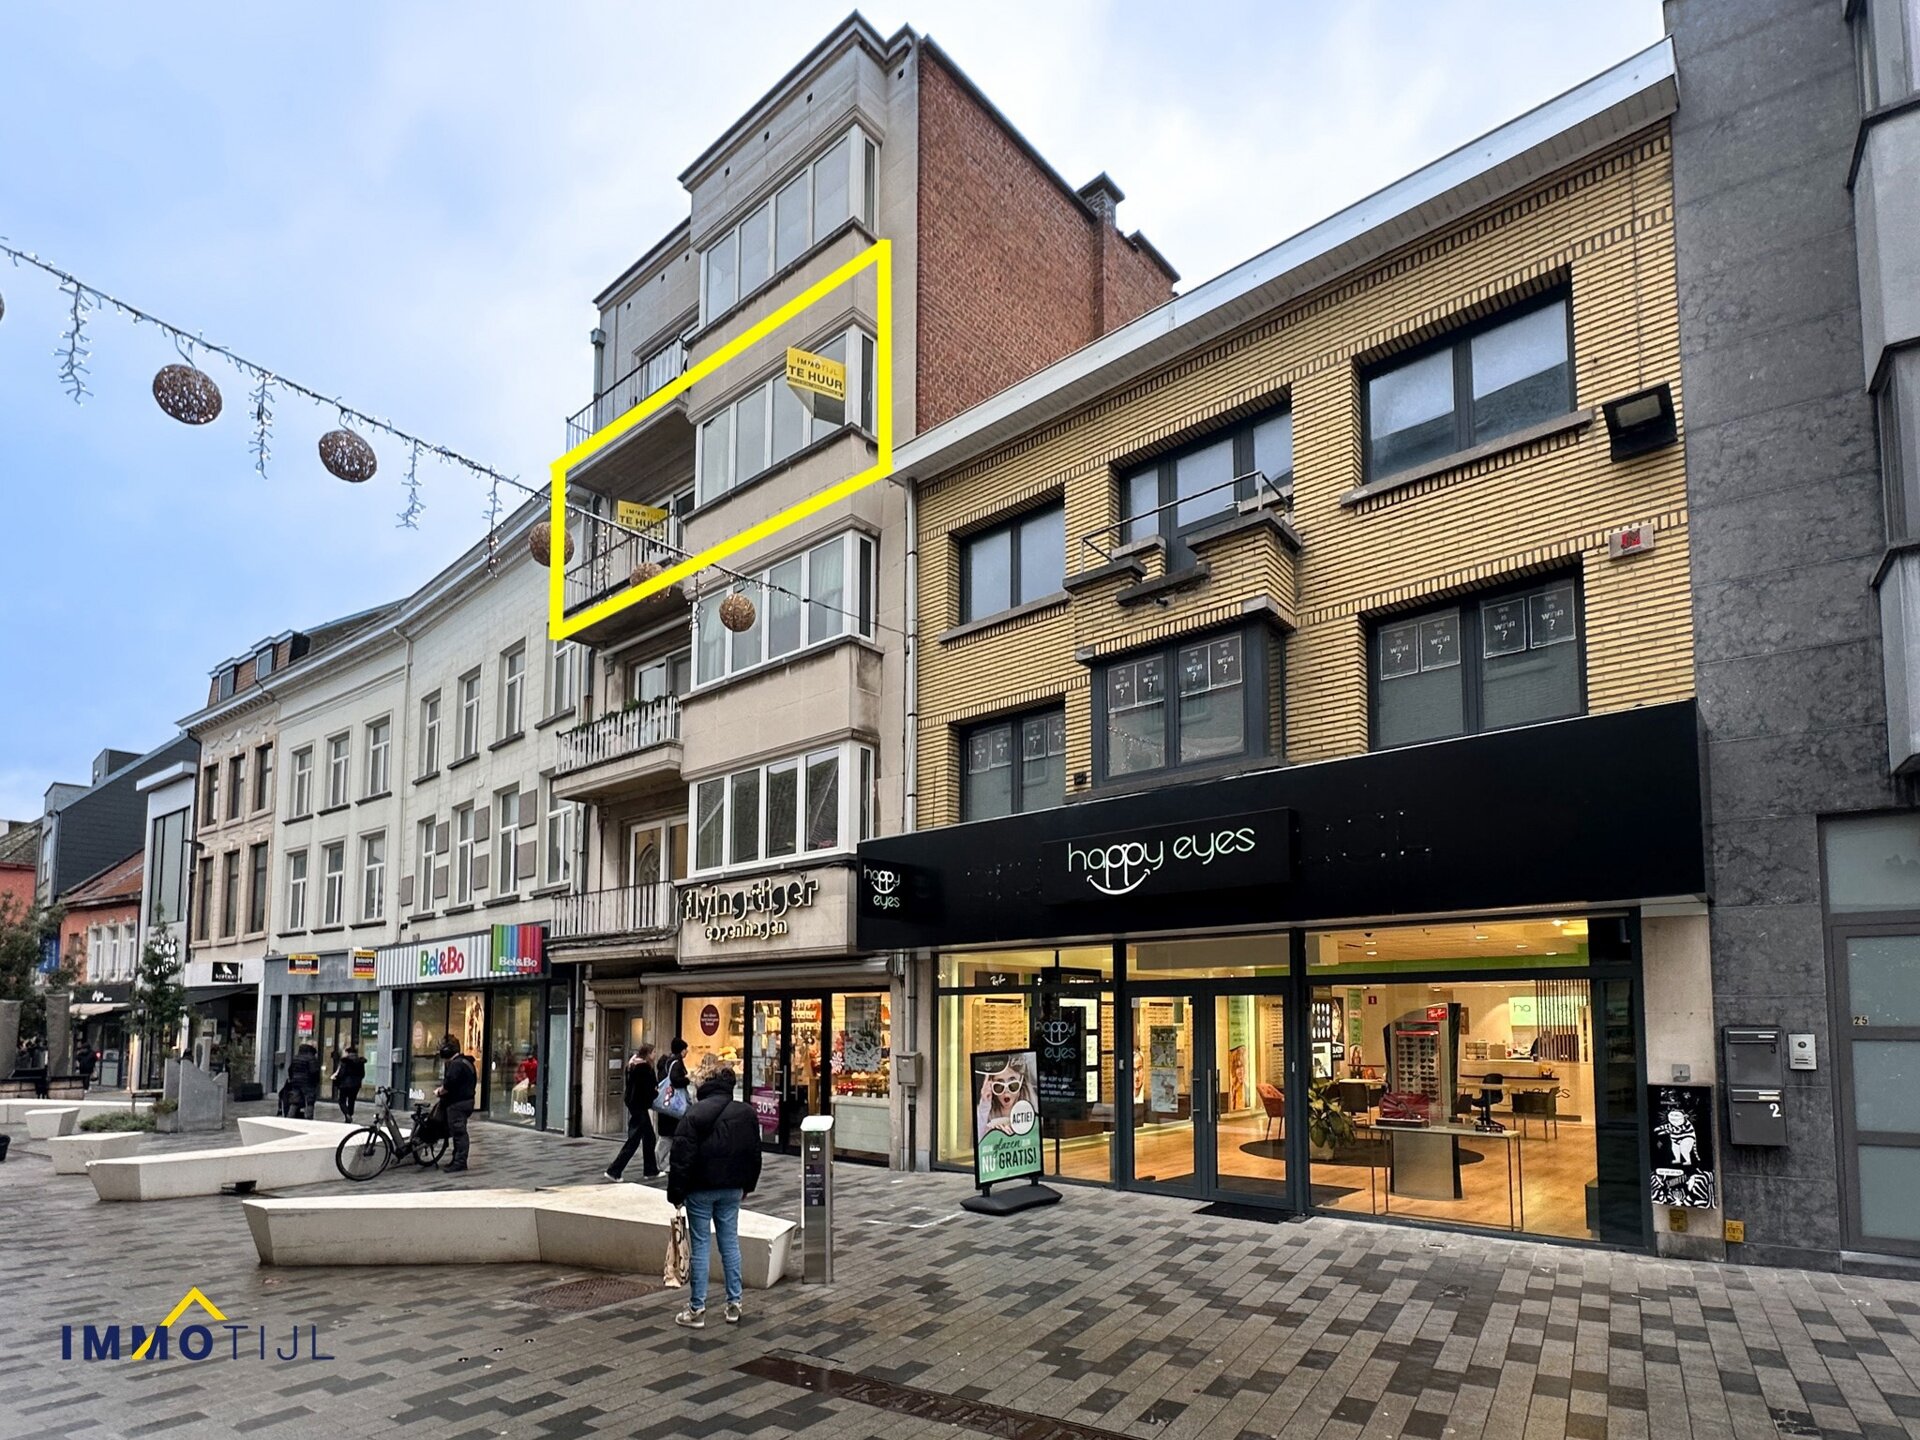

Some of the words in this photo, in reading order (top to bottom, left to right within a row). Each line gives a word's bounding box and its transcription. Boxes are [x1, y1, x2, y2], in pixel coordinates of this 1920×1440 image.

[788, 365, 804, 379] TE
[808, 370, 842, 391] HUUR
[620, 515, 632, 525] TE
[1549, 620, 1556, 630] ?
[1501, 630, 1508, 641] ?
[1437, 644, 1443, 655] ?
[1396, 653, 1402, 664] ?
[1222, 664, 1228, 674] ?
[1191, 672, 1197, 682] ?
[1068, 841, 1164, 889] happy
[1173, 827, 1256, 865] eyes
[863, 864, 901, 891] happy
[682, 885, 749, 925] flying
[751, 876, 820, 917] tiger
[873, 895, 901, 910] eyes
[705, 918, 789, 942] copenhagen
[420, 946, 465, 976] Bel&Bo
[498, 956, 538, 968] Bel&Bo
[1853, 1016, 1869, 1026] 25
[1034, 1018, 1077, 1042] happy
[1044, 1046, 1077, 1062] eyes
[513, 1101, 536, 1116] Bel&Bo
[756, 1101, 777, 1115] 30%
[1769, 1103, 1782, 1118] 2
[1012, 1111, 1033, 1125] ACTIE!
[992, 1138, 1020, 1158] glazen
[982, 1155, 996, 1174] NU
[999, 1147, 1037, 1170] GRATIS!
